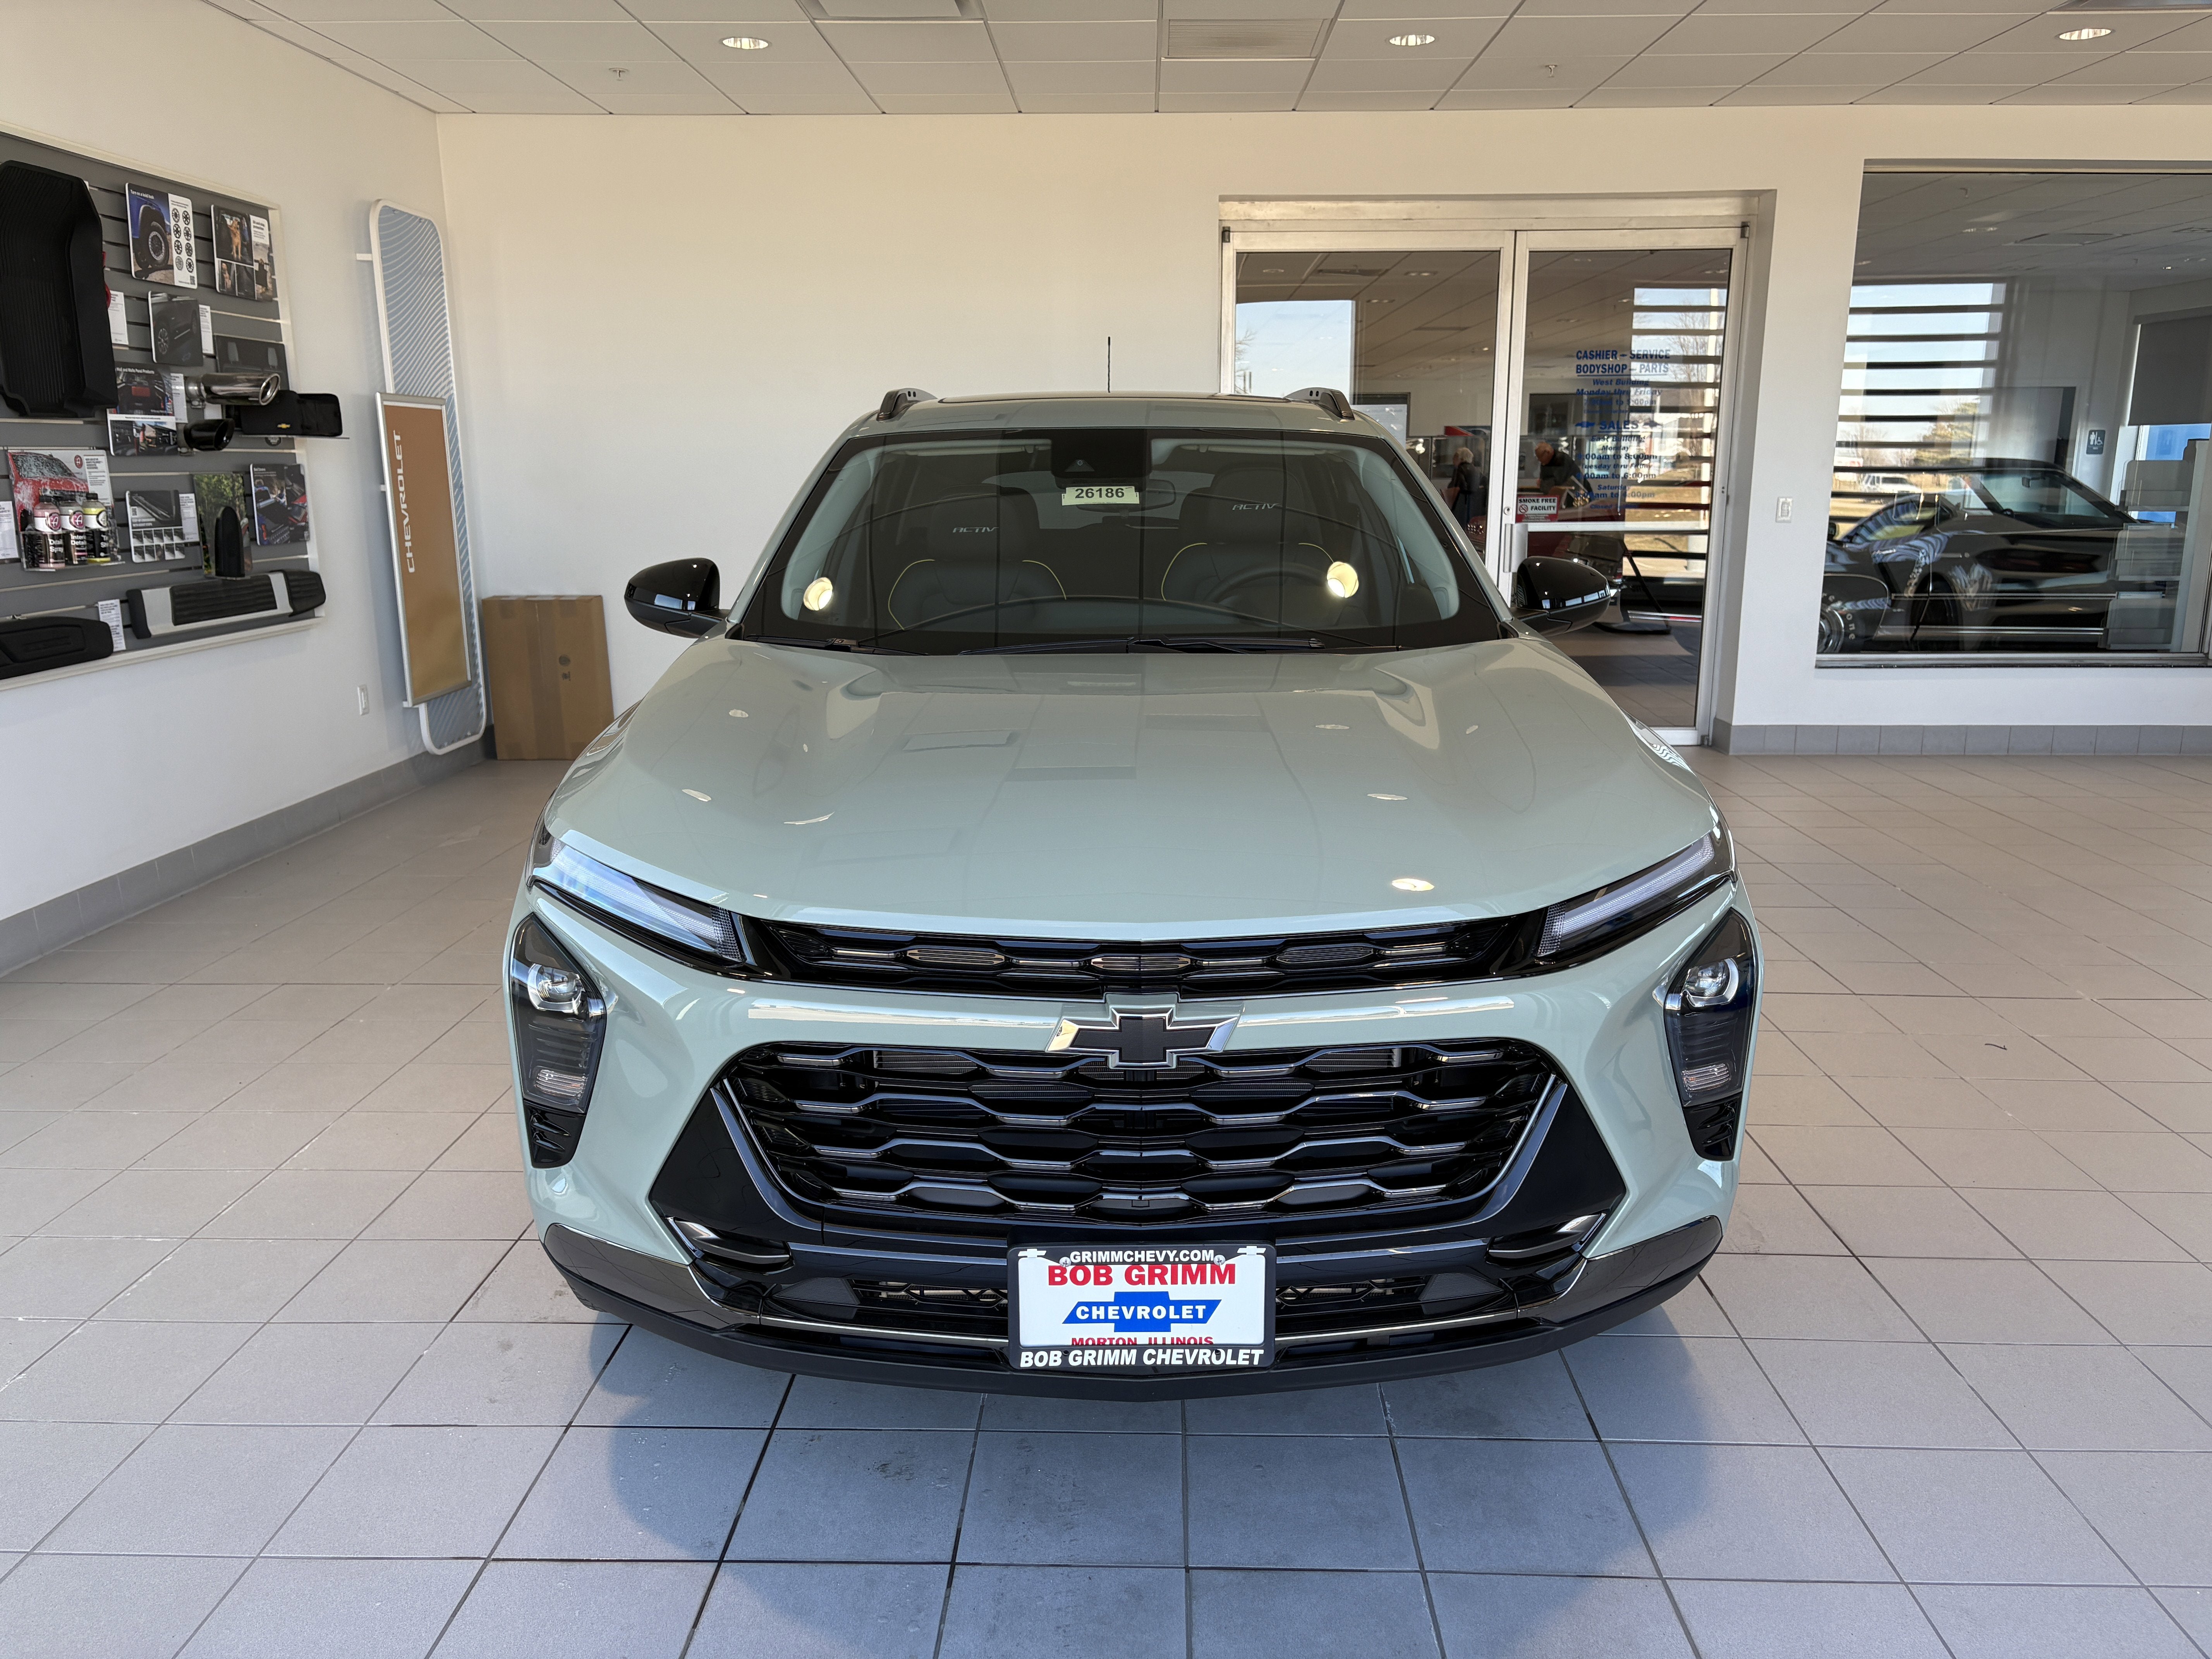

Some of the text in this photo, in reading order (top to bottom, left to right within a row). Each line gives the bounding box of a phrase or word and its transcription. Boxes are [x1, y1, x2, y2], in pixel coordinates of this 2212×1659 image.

[1576, 350, 1670, 360] CASHIER SERVICE
[1576, 364, 1669, 374] BODYSHOP PARTS
[1634, 388, 1663, 396] Friday
[1599, 420, 1638, 429] SALES
[1075, 488, 1125, 498] 26186
[393, 429, 415, 573] CHEVROLET
[1070, 1250, 1214, 1263] GRIMMCHEVY.COM
[1048, 1264, 1235, 1286] BOB GRIMM
[1076, 1305, 1207, 1319] CHEVROLET
[1071, 1337, 1137, 1345] MORTON
[1020, 1348, 1264, 1367] BOB GRIMM CHEVROLET
